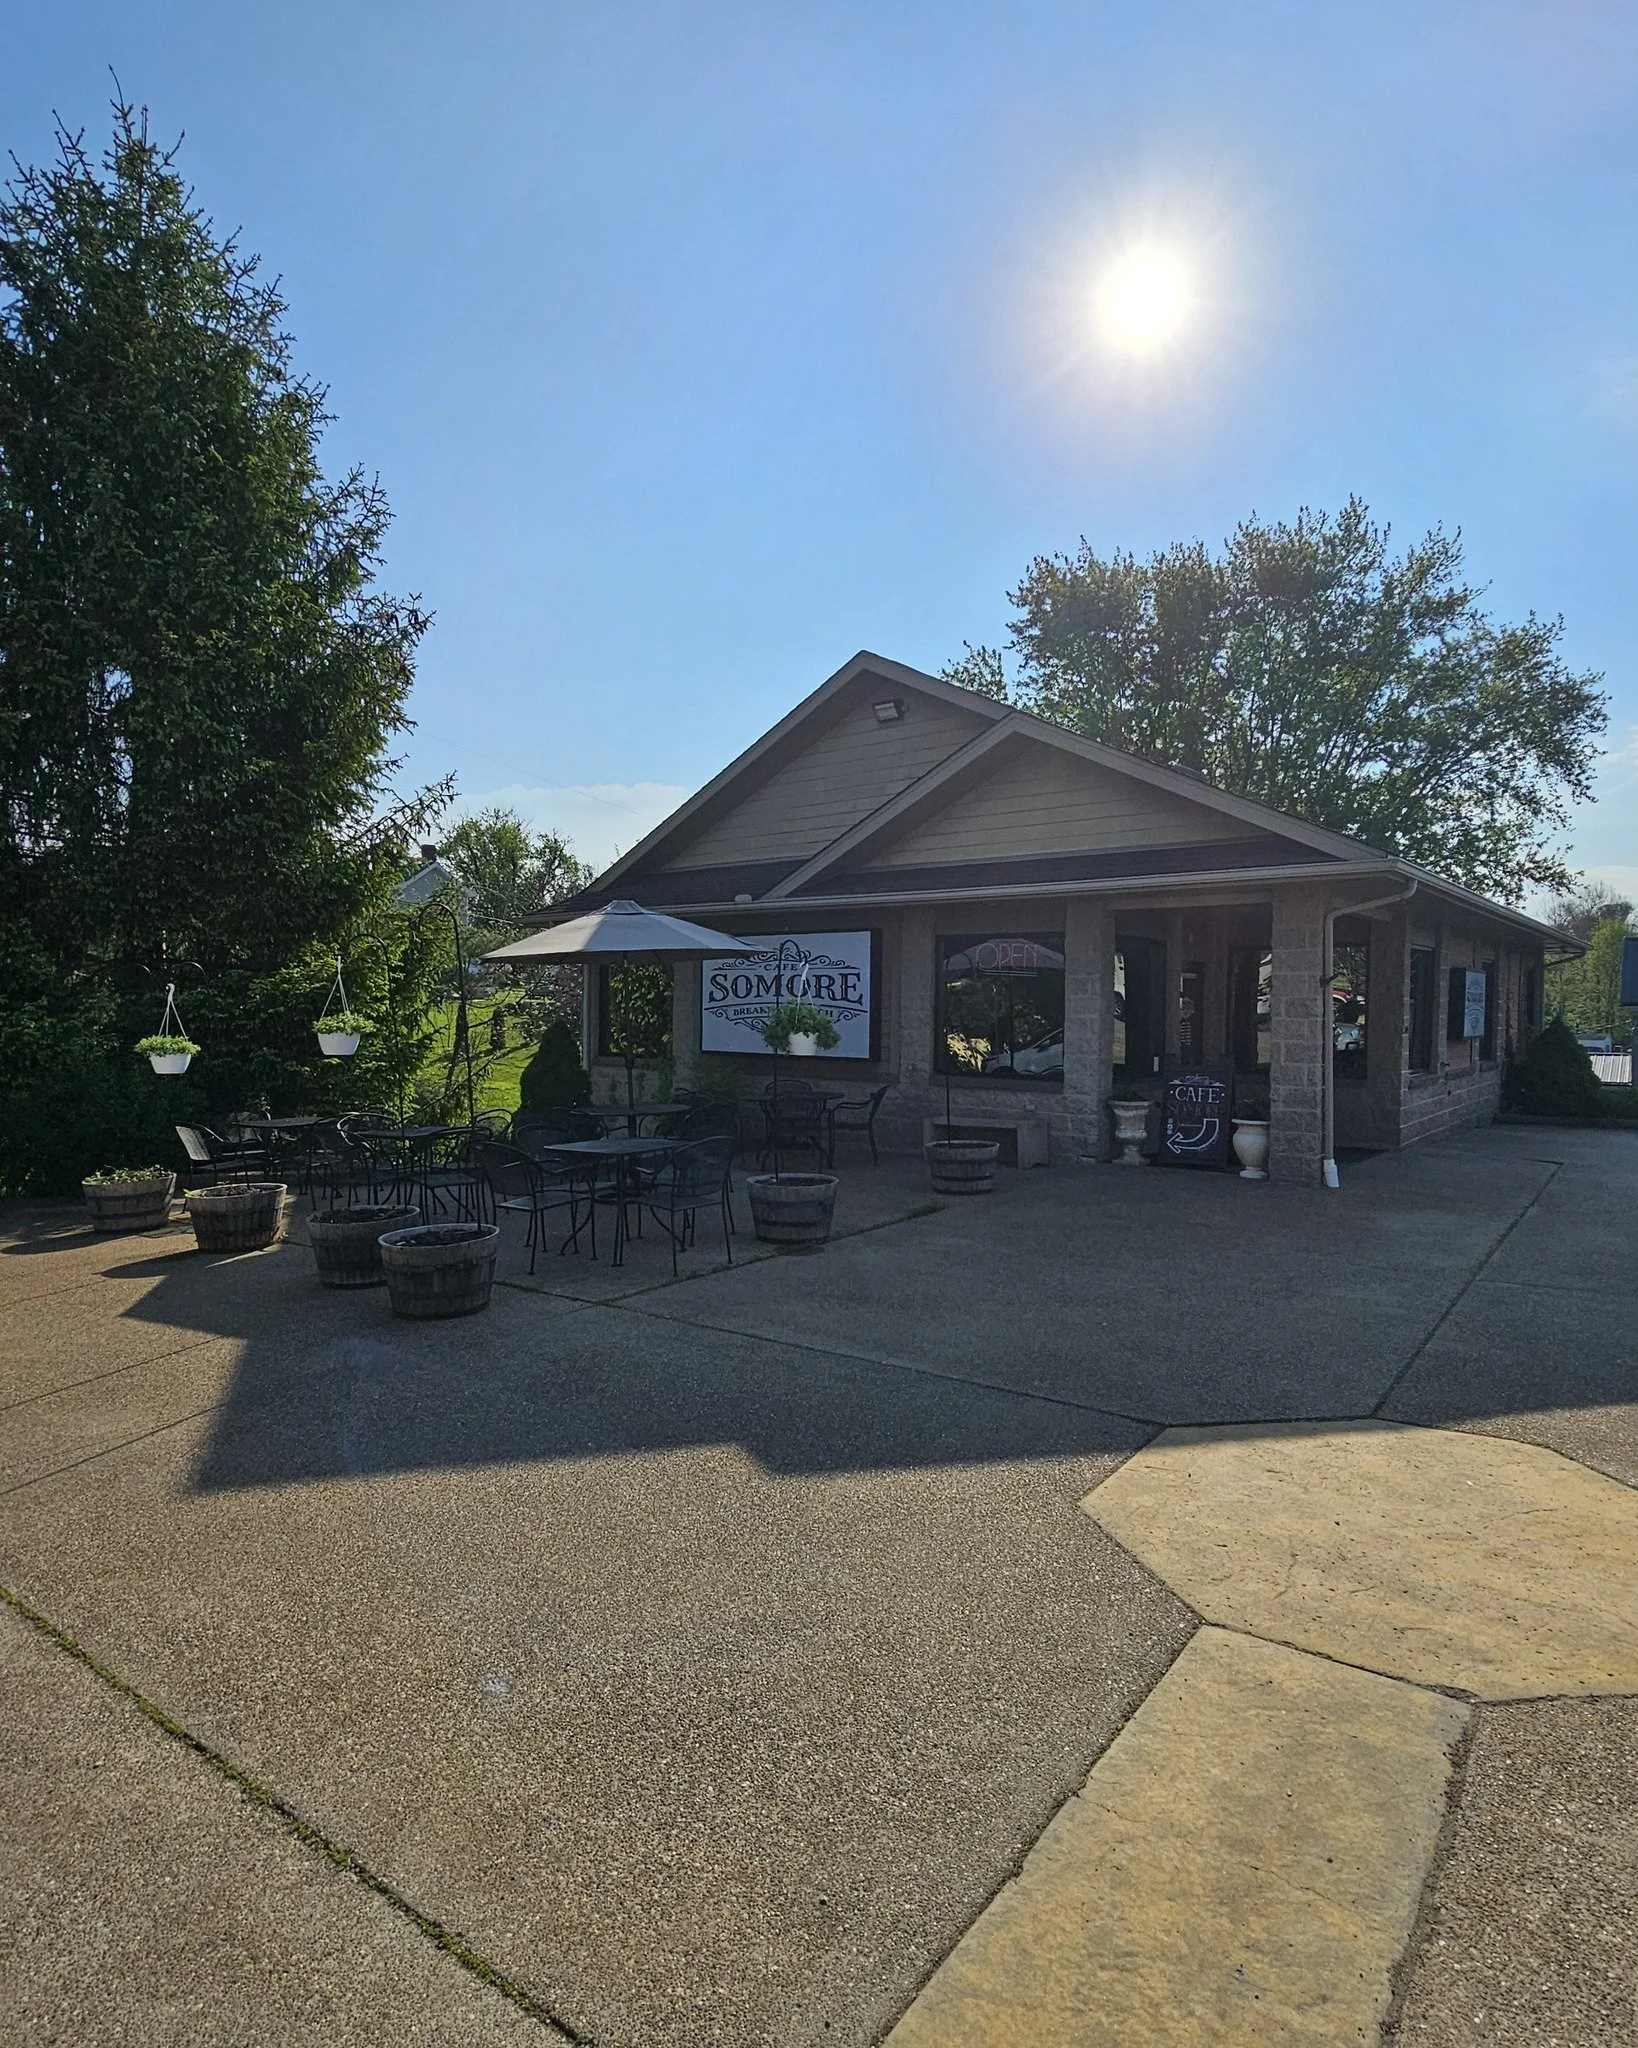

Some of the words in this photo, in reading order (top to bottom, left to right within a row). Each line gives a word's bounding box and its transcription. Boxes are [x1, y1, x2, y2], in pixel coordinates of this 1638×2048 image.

[976, 942, 1037, 970] OPEN
[708, 972, 863, 1006] SOMORE
[733, 1006, 773, 1016] BREAK
[1175, 1086, 1219, 1103] CAFE
